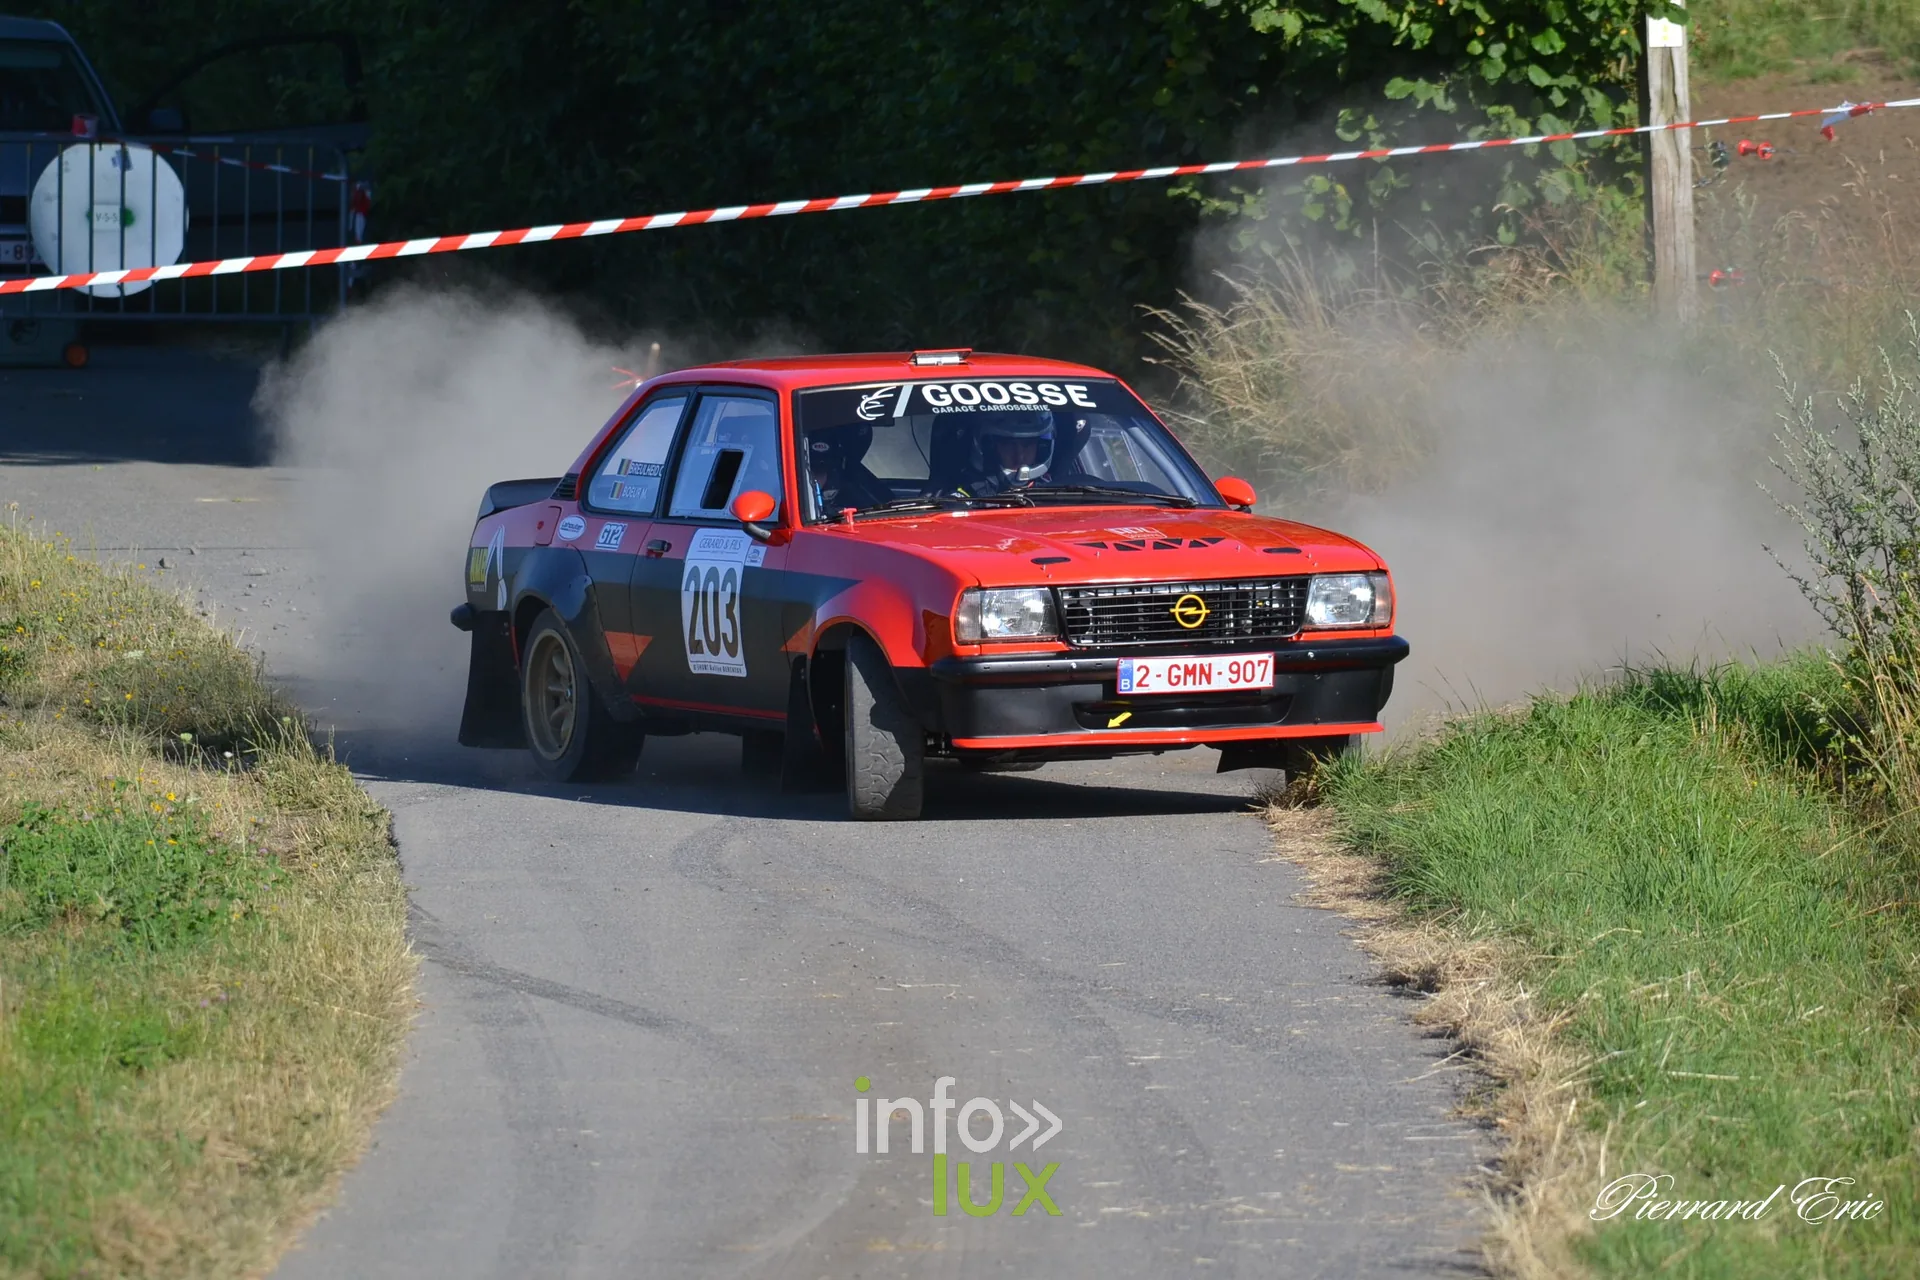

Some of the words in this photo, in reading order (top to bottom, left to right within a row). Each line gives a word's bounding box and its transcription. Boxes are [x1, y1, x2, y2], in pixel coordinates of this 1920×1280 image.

[921, 382, 1097, 408] GOOSSE
[932, 404, 977, 414] GARAGE
[979, 403, 1051, 412] CARROSSERIE
[685, 565, 739, 658] 203
[1121, 678, 1131, 690] B
[1136, 659, 1270, 688] 2-GMN-907
